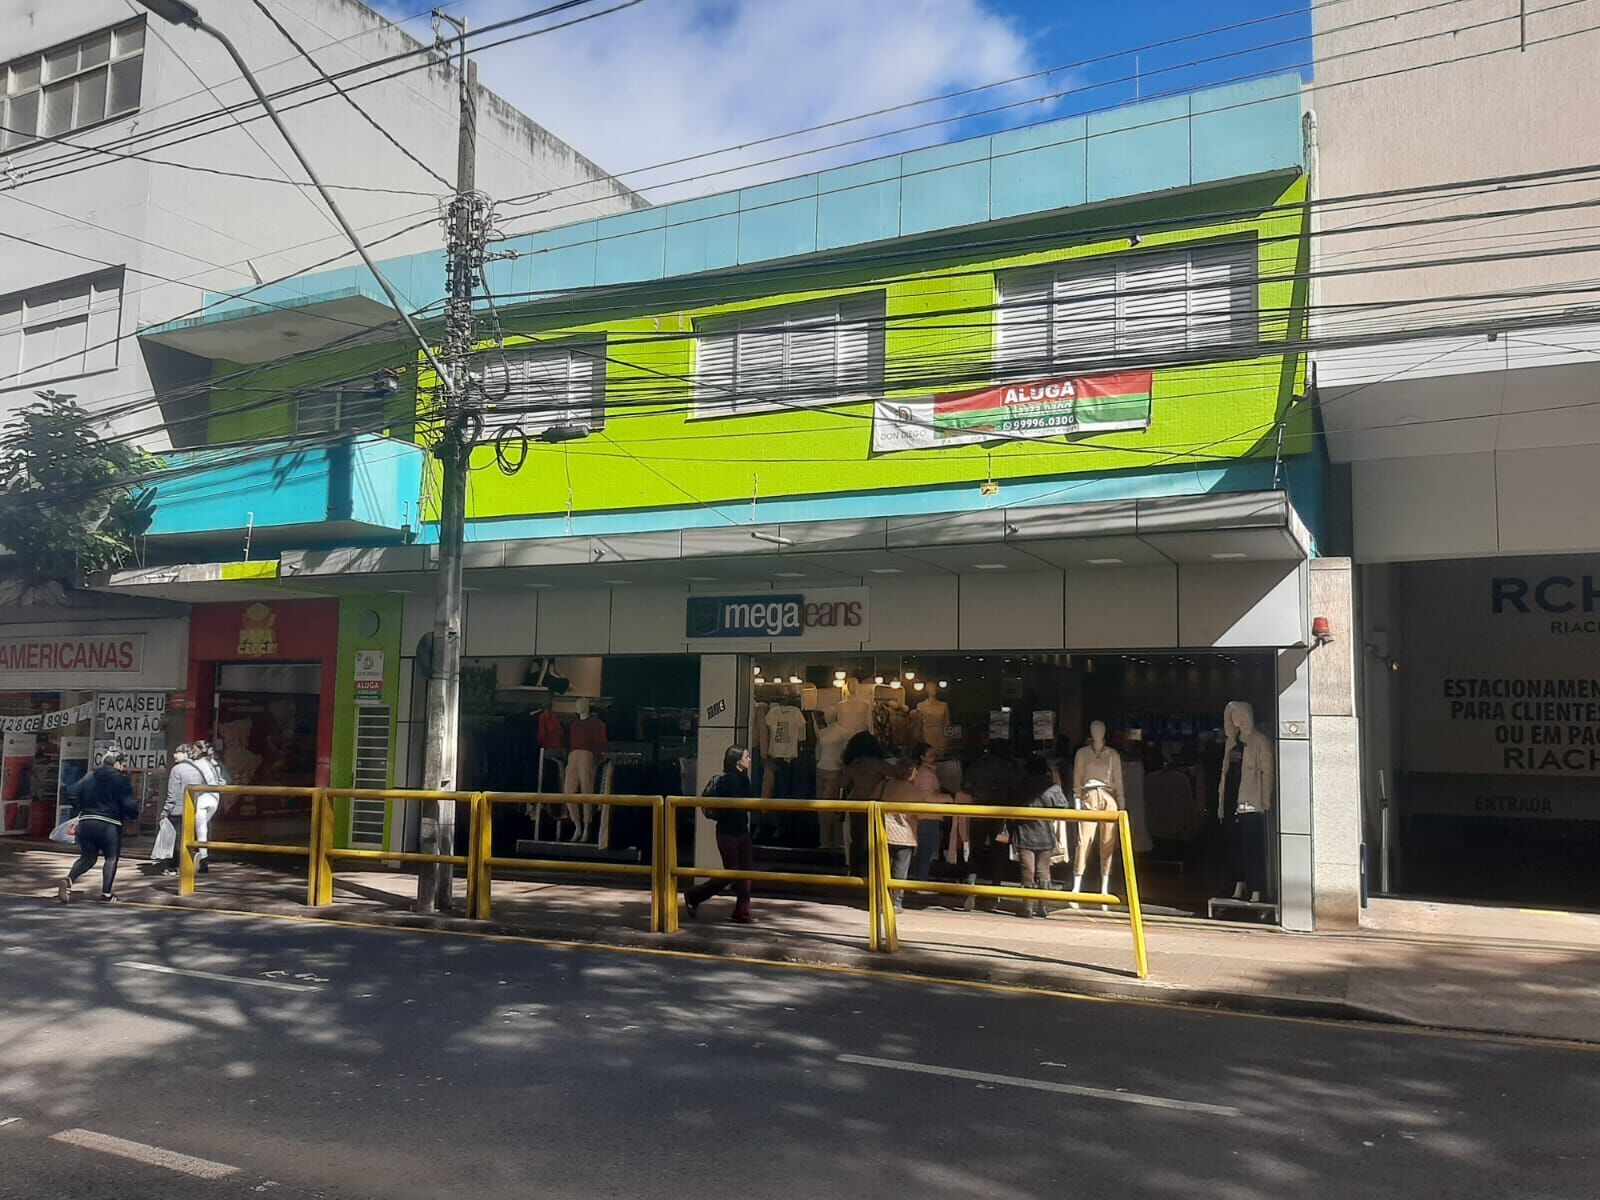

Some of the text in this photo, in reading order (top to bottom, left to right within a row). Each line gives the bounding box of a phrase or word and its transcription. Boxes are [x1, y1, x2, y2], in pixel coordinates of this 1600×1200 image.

[1004, 380, 1075, 404] ALUGA
[1014, 415, 1074, 430] 99996.0300
[880, 429, 927, 441] DON DIEGO
[1550, 620, 1600, 634] RIAC
[0, 641, 133, 669] AMERICANAS
[357, 681, 379, 689] ALUGA
[98, 697, 133, 712] FAÇA
[137, 697, 164, 711] SEU
[1451, 700, 1600, 722] PARA CLIENTE
[106, 714, 160, 731] CARTÃO
[1495, 725, 1524, 744] OU
[1531, 725, 1562, 745] EM
[117, 736, 147, 751] AQUI
[1474, 795, 1553, 814] ENTRADA
